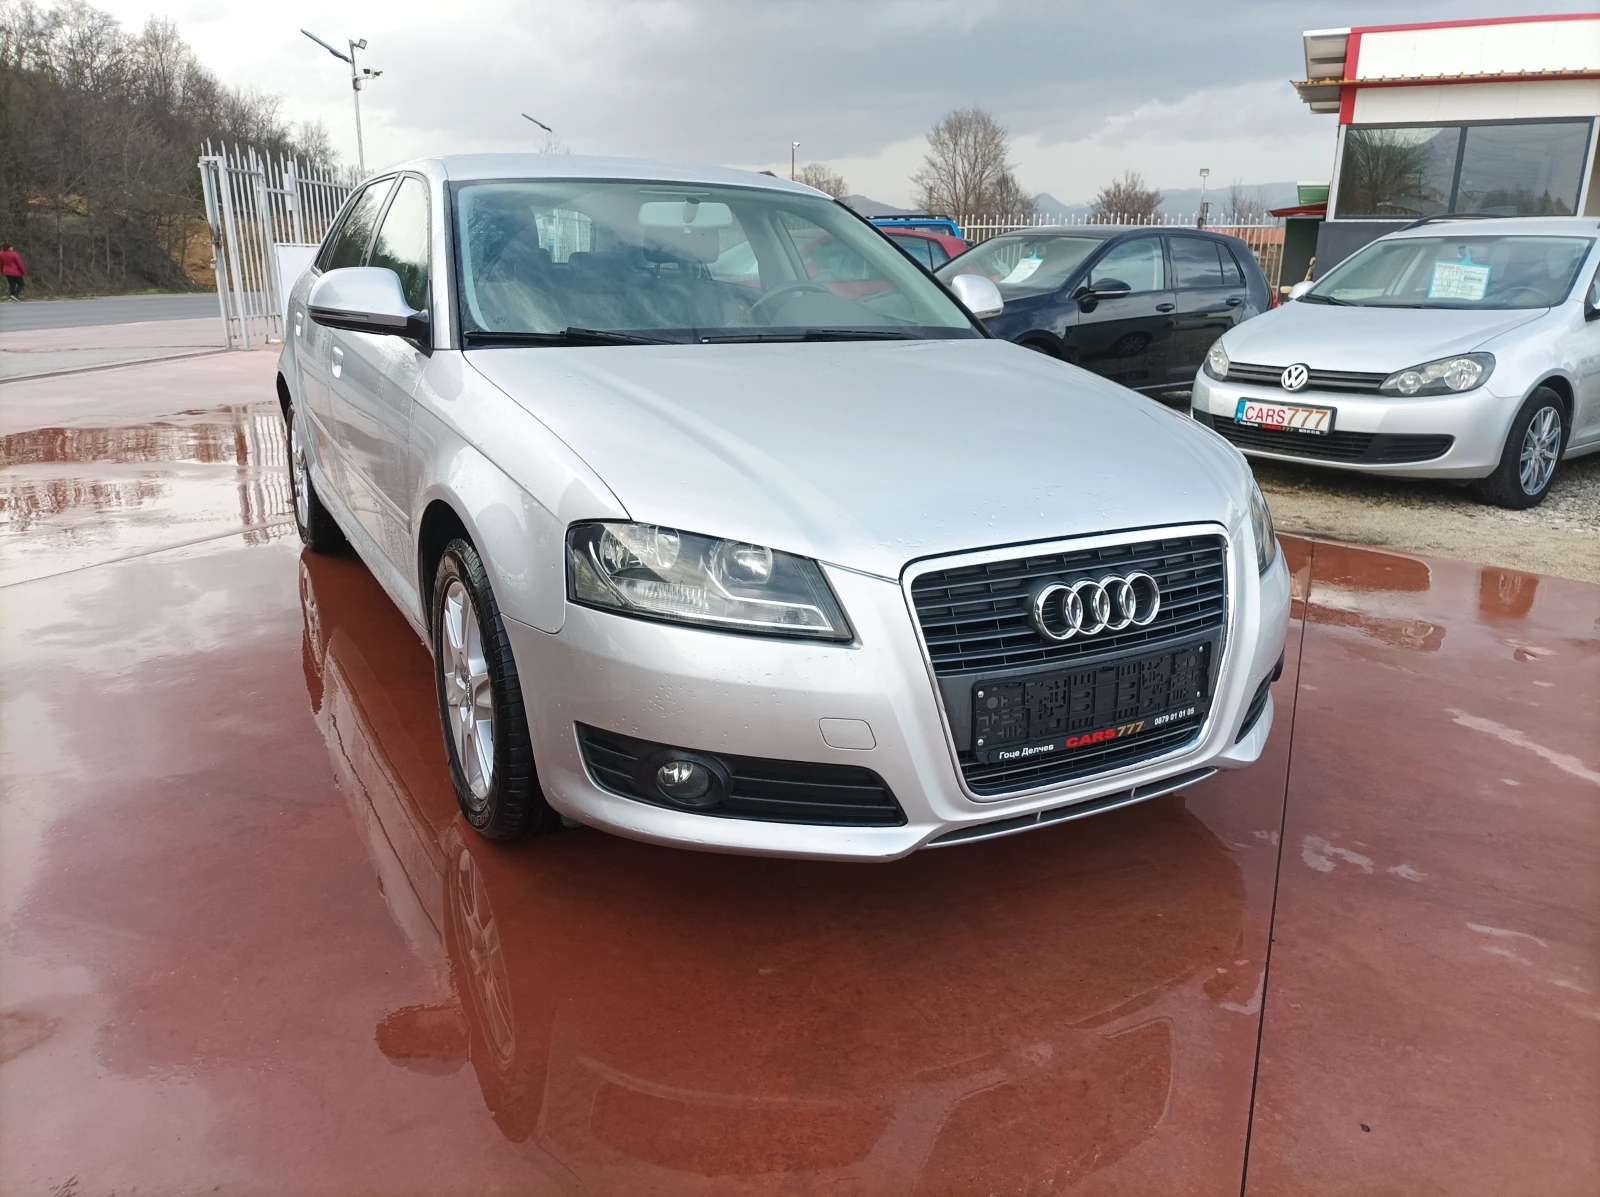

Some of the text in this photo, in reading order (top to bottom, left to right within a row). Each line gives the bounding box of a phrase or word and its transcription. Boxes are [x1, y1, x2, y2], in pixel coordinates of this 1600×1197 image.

[1245, 406, 1328, 430] CARS777
[1154, 715, 1170, 726] 0879
[1170, 712, 1178, 721] 01
[1178, 709, 1186, 718] 01
[999, 744, 1054, 759] Гоце Делчев
